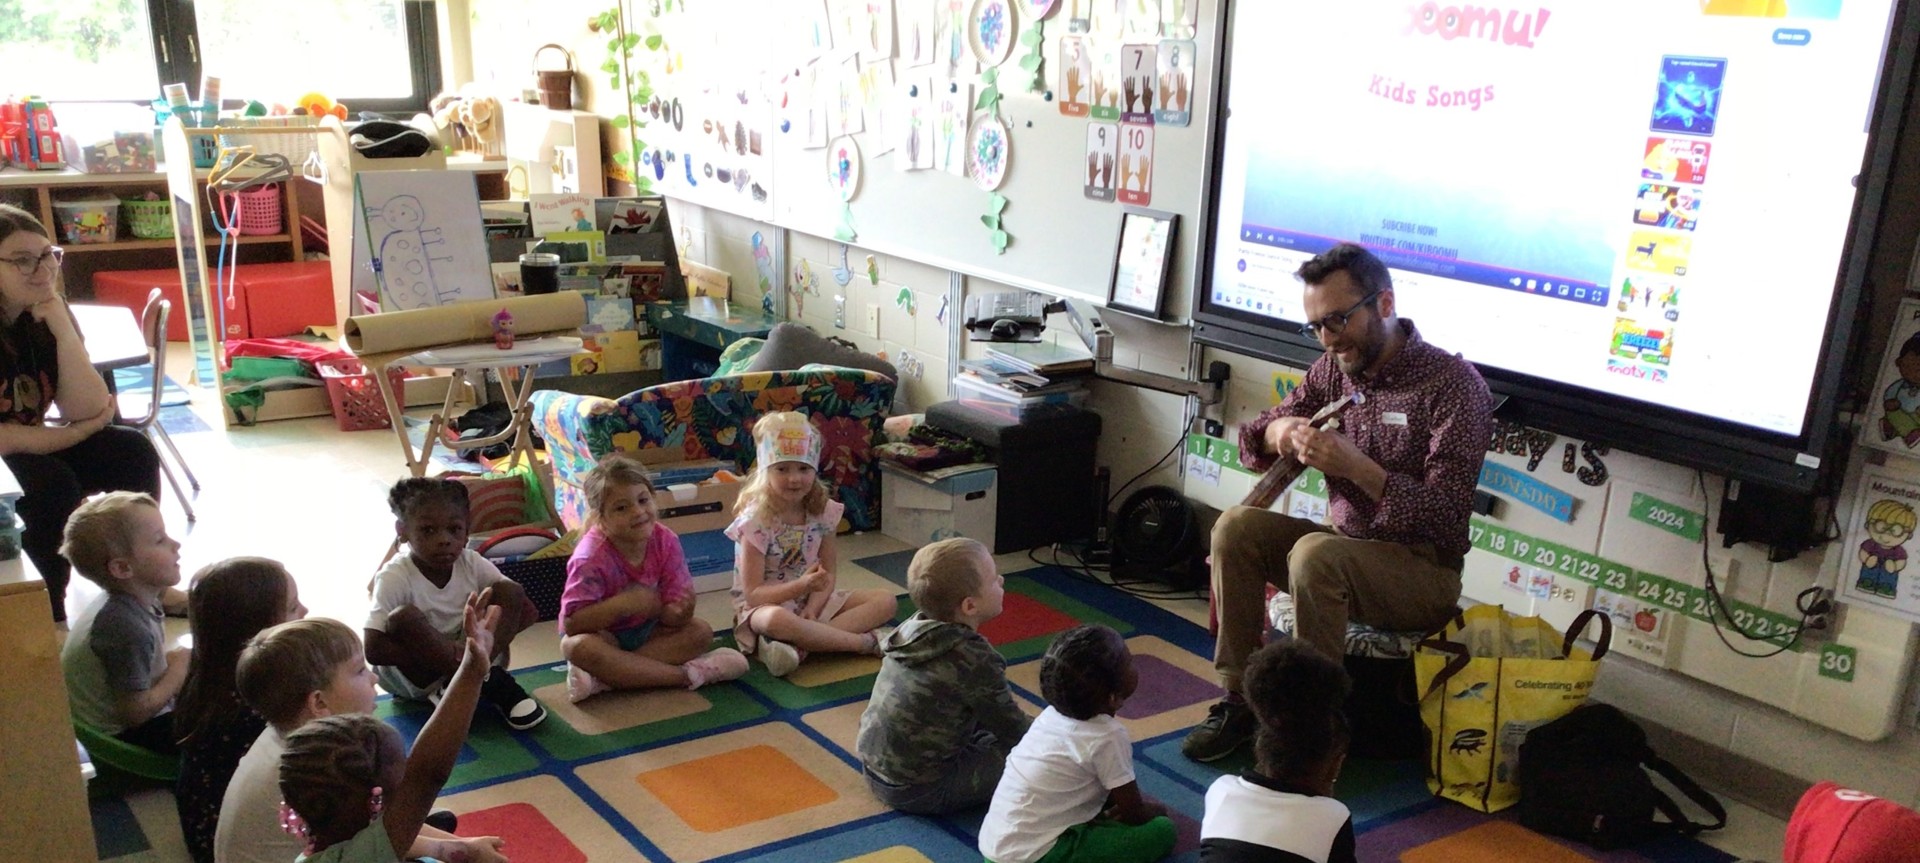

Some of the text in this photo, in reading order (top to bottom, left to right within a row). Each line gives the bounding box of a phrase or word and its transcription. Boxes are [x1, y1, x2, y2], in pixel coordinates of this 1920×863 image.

[1134, 49, 1143, 71] 7
[1170, 45, 1180, 67] 8
[1368, 73, 1495, 111] Kids Songs
[1129, 115, 1148, 123] seven
[1162, 113, 1179, 124] eight
[1097, 126, 1106, 147] 9
[1128, 128, 1145, 150] 10
[539, 201, 559, 211] Went
[559, 195, 591, 207] Walking
[1091, 187, 1105, 198] nine
[1127, 192, 1138, 201] ten
[1381, 218, 1438, 238] SUBCRIBE NOW!
[1360, 233, 1459, 260] YOUTUBECOM/KIBOOMU
[1194, 440, 1201, 454] 1
[1206, 445, 1215, 458] 2
[1222, 449, 1231, 463] 3
[1299, 475, 1327, 493] 8 9
[1648, 506, 1685, 531] 2024
[1469, 525, 1485, 543] 17
[1489, 532, 1506, 551] 18
[1512, 539, 1530, 558] 19
[1534, 547, 1556, 567] 20
[1559, 554, 1578, 575] 21
[1578, 560, 1601, 581] 22
[1604, 569, 1627, 589] 23
[1637, 579, 1661, 601] 24
[1663, 587, 1687, 609] 25
[1733, 609, 1755, 630] 27
[1754, 617, 1774, 636] 2
[1823, 651, 1850, 673] 30
[1514, 679, 1573, 692] Celebrating
